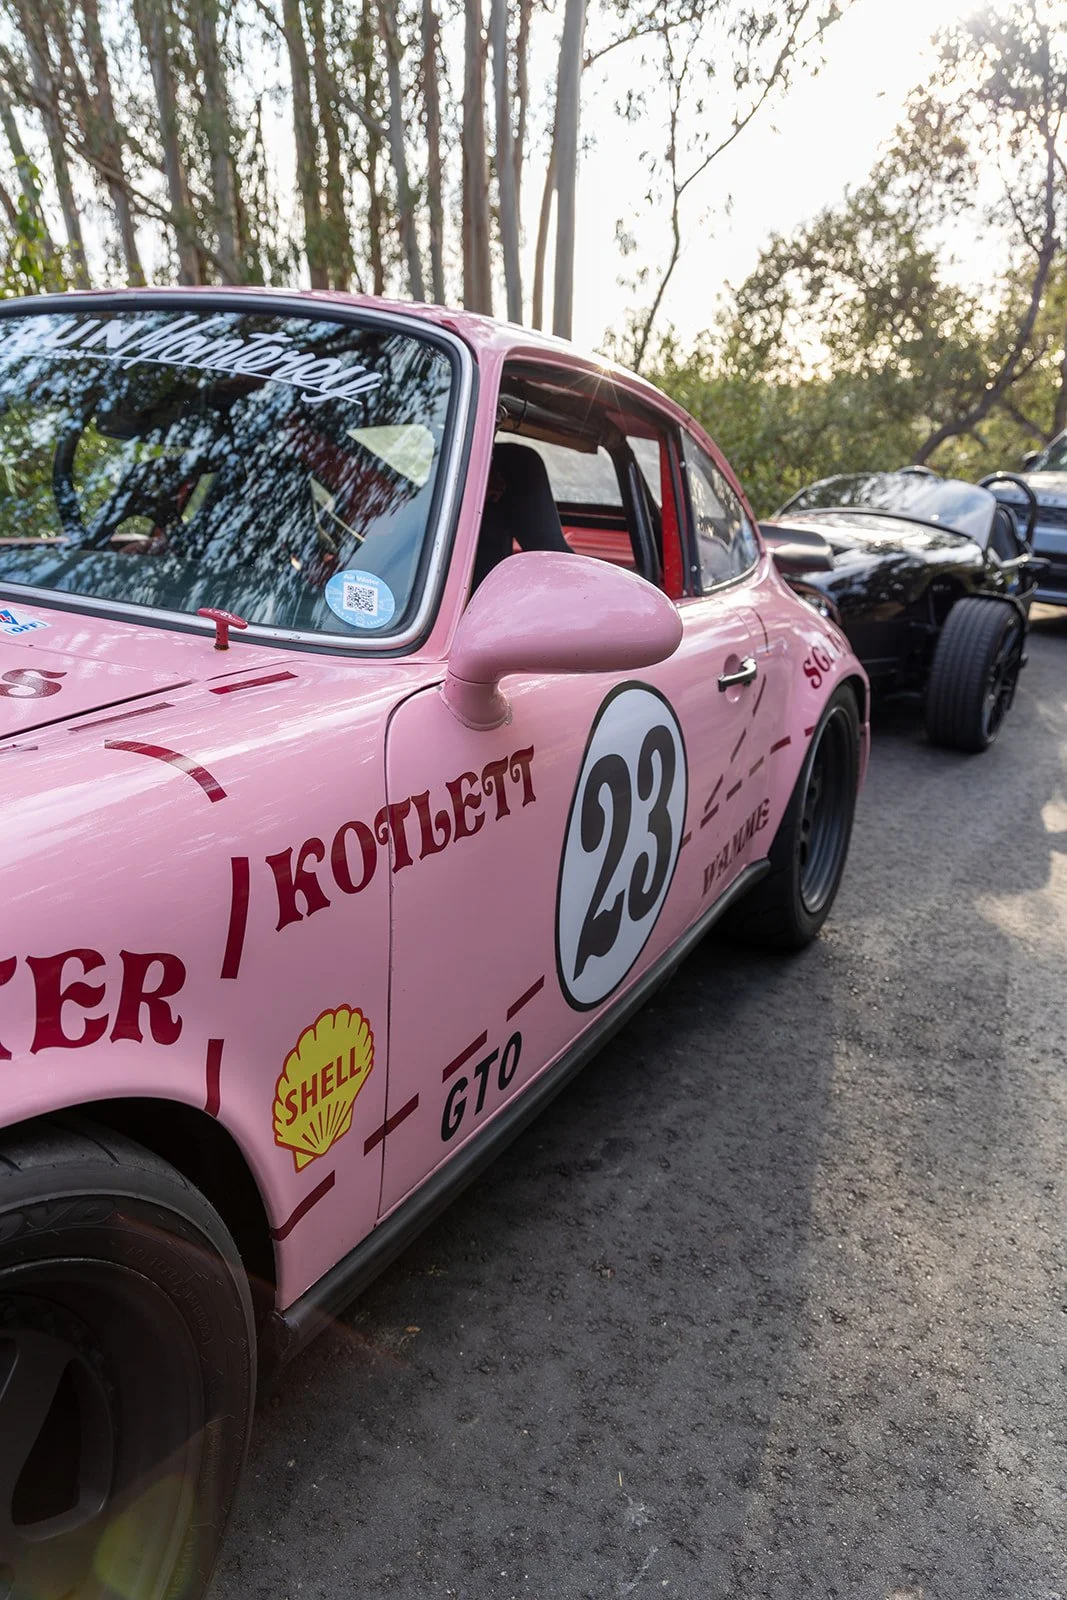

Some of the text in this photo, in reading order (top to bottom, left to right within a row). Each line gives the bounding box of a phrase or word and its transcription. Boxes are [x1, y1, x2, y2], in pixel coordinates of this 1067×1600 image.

[109, 315, 382, 403] Monterey
[265, 745, 537, 932] KOTLETT
[573, 725, 677, 981] 23
[285, 1046, 362, 1126] SHELL
[441, 1031, 522, 1142] GTO
